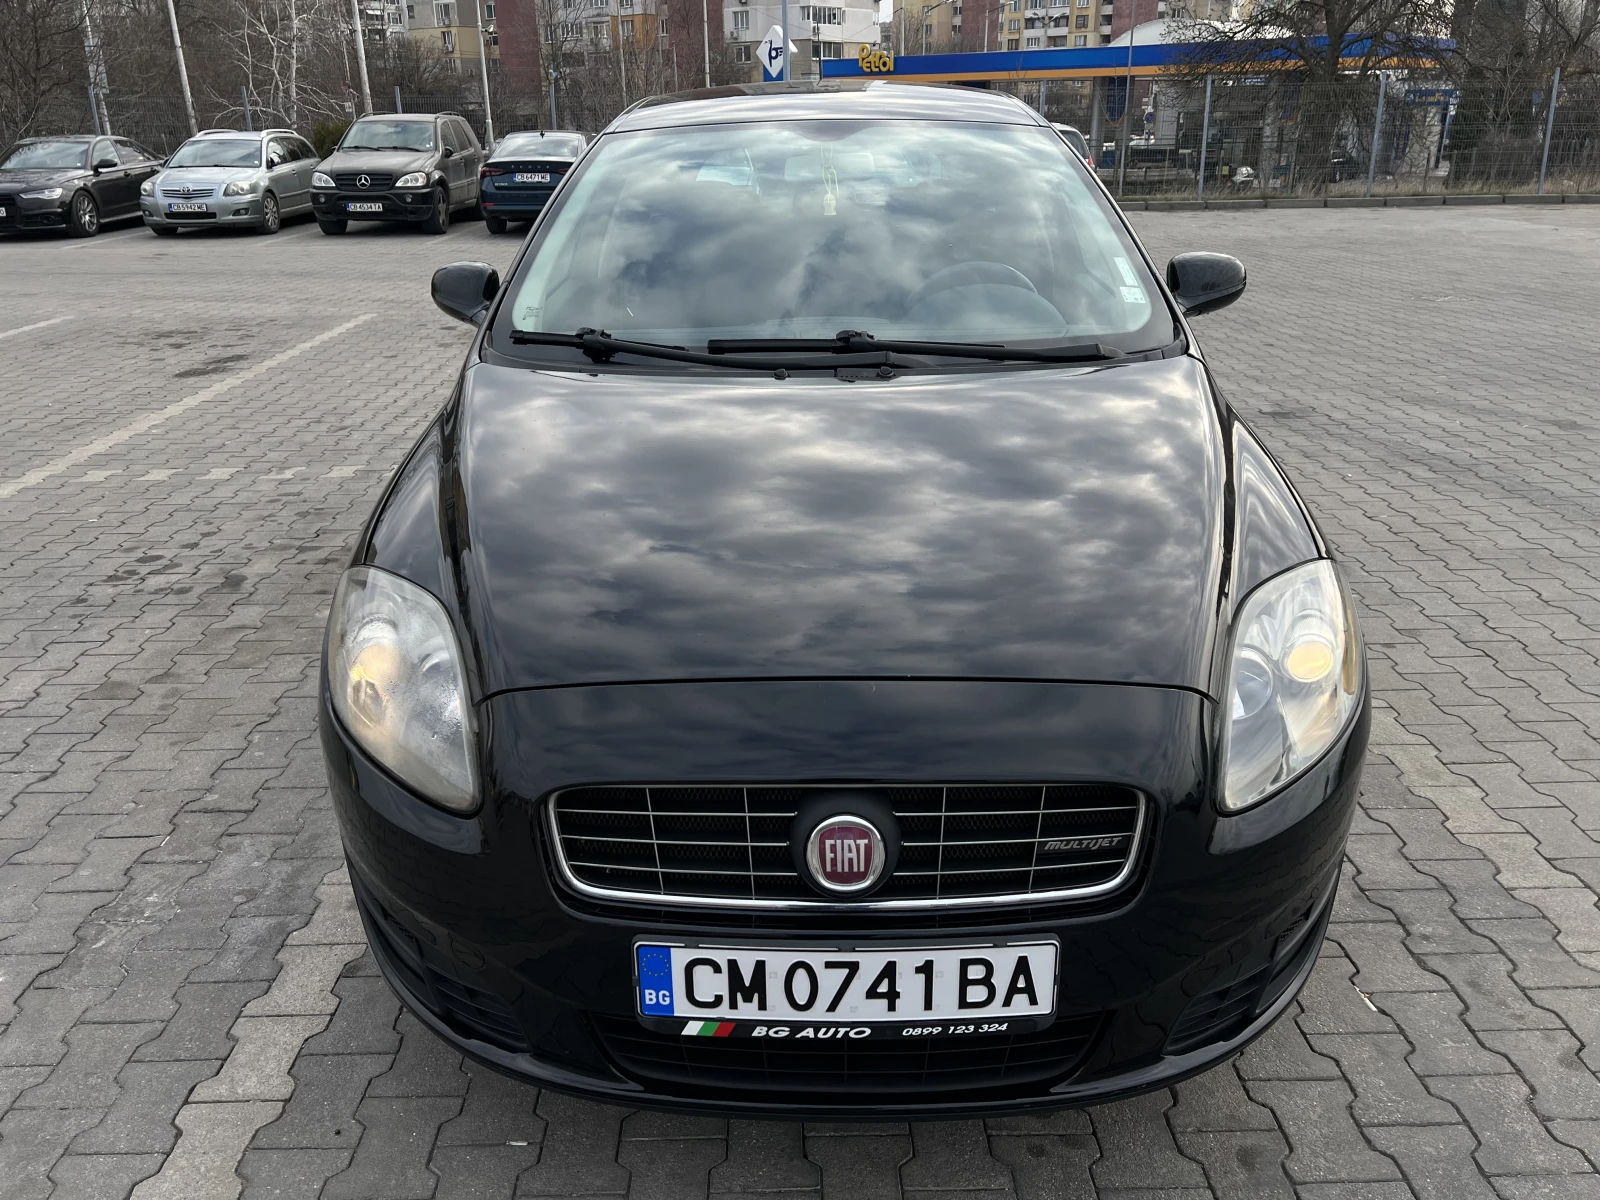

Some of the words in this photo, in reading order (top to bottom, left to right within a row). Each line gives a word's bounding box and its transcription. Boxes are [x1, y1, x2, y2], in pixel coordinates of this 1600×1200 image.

[859, 44, 894, 72] Petrol
[1044, 837, 1122, 850] MULTIJET
[825, 839, 869, 873] FIAT
[684, 957, 768, 1011] CM
[783, 959, 935, 1013] 0741
[957, 955, 1039, 1010] BA
[644, 989, 671, 1006] BG
[751, 1026, 791, 1038] BG
[795, 1026, 872, 1039] AUTO
[901, 1026, 943, 1037] 0899
[948, 1024, 975, 1035] 123
[978, 1022, 1009, 1033] 324
